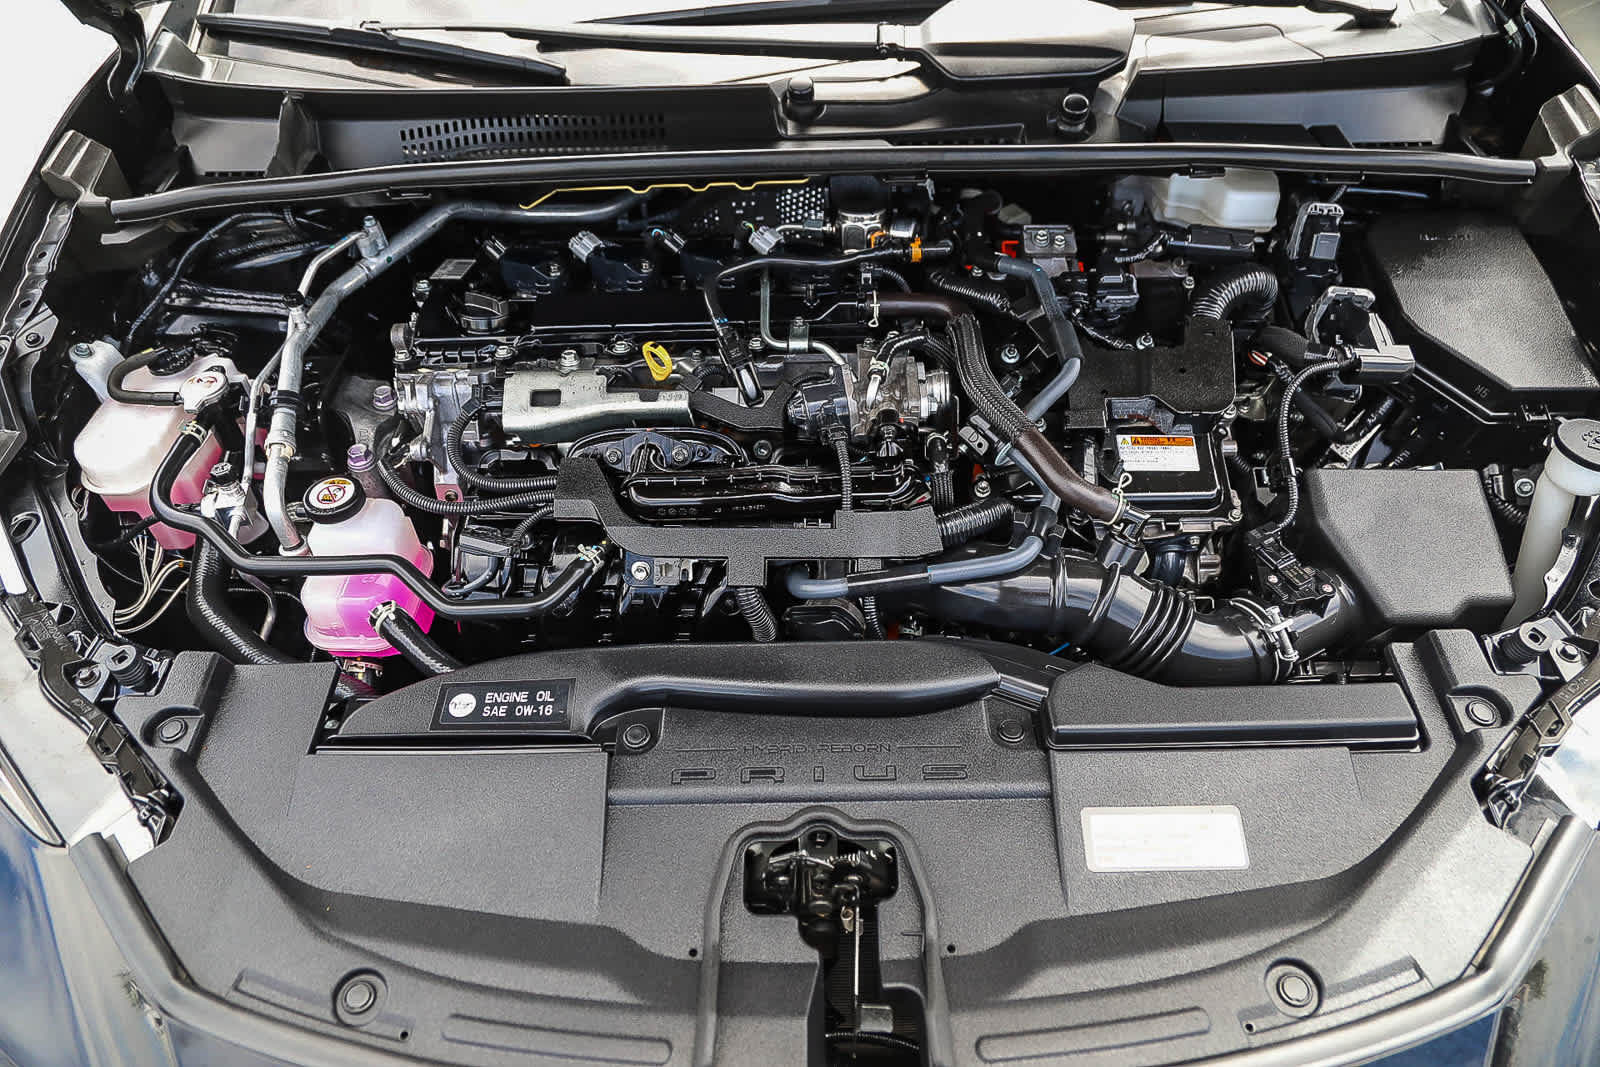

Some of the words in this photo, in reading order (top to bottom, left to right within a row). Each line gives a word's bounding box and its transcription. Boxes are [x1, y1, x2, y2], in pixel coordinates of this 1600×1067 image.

[485, 692, 529, 703] ENGINE
[536, 690, 555, 703] OIL
[482, 705, 508, 716] SAE
[515, 704, 553, 716] 0W-16
[743, 743, 808, 754] HYBRID
[815, 742, 892, 753] REBORN
[671, 765, 969, 784] PRIUS
